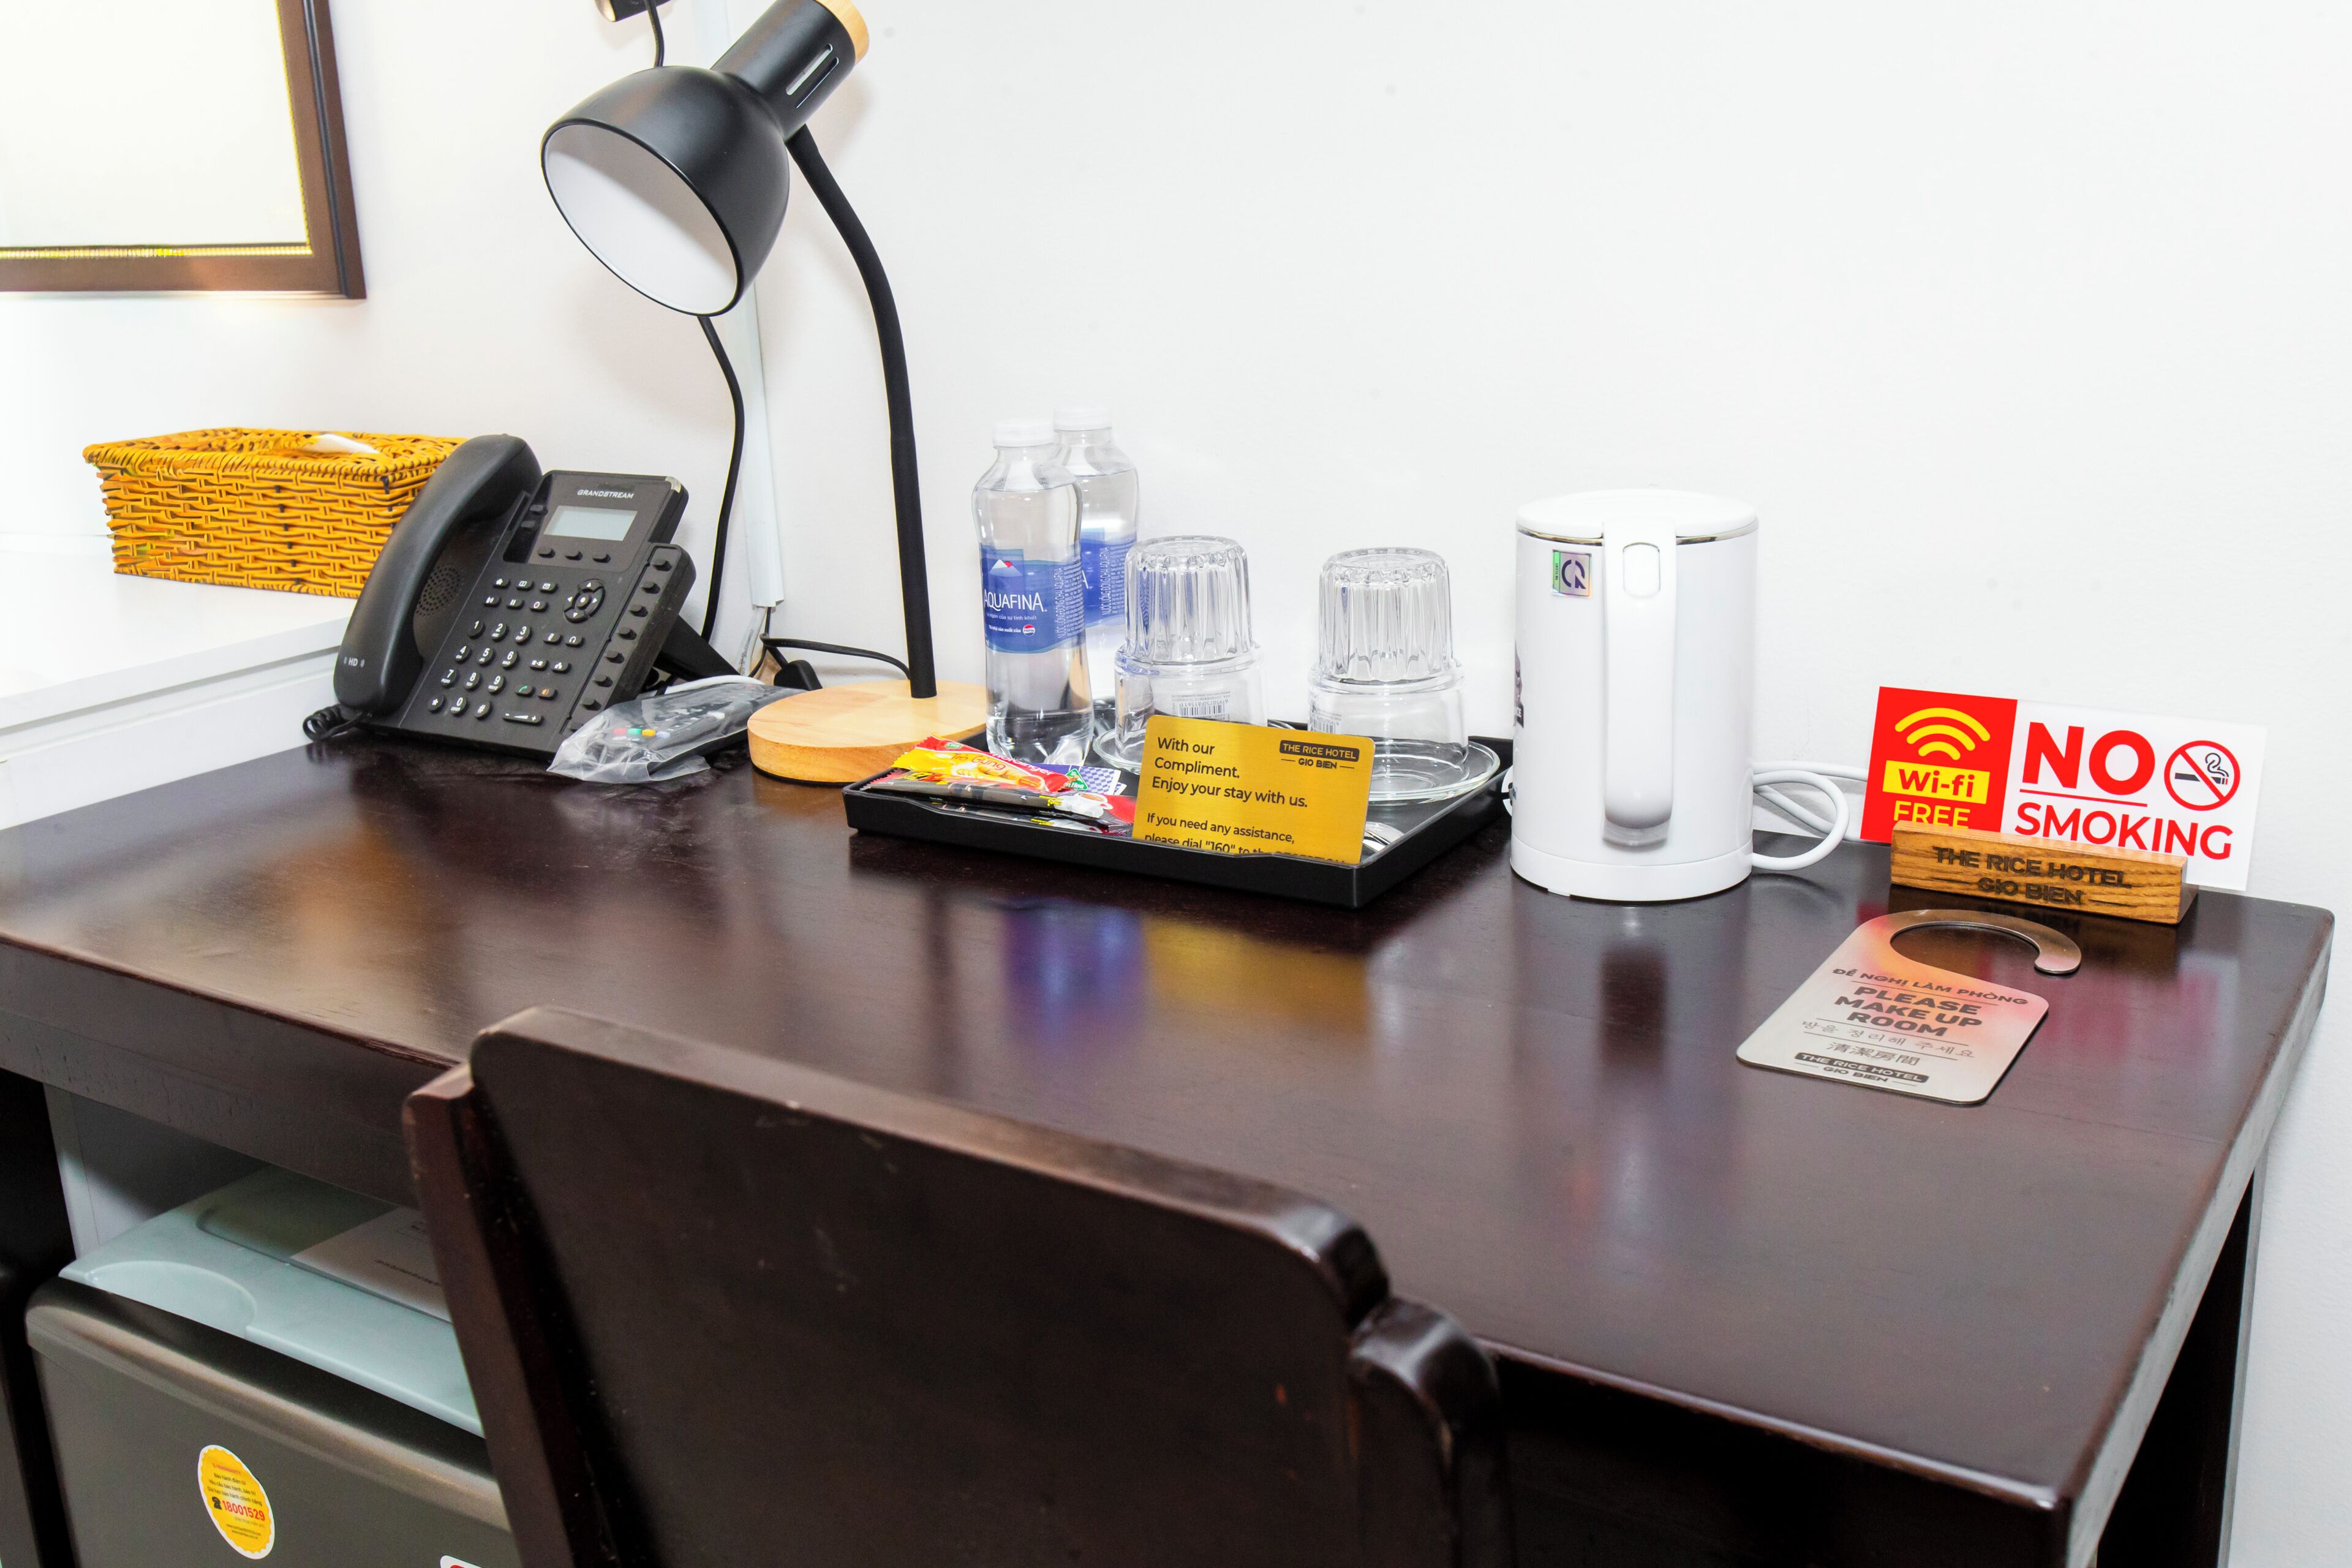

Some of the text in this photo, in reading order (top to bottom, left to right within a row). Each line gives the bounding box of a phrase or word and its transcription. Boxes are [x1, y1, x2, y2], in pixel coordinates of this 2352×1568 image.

[578, 489, 635, 499] GRANDSTREAM
[984, 589, 1045, 612] AQUAFINA
[473, 620, 480, 629] 1
[495, 623, 503, 632] 2
[520, 626, 527, 635] 3
[459, 646, 467, 654] 4
[483, 648, 491, 657] 5
[507, 651, 514, 660] 6
[348, 657, 358, 667] HD
[447, 669, 454, 678] 7
[469, 672, 477, 682] 8
[494, 676, 501, 685] 9
[457, 697, 464, 706] 0
[1158, 737, 1215, 755] With our
[1283, 743, 1357, 760] THE RICE HOTEL
[1155, 756, 1240, 778] Compliment.
[1298, 758, 1338, 769] GIO BIEN
[2022, 722, 2155, 796] NO
[1152, 776, 1308, 807] Enjoy your stay with us.
[1899, 769, 1975, 797] Wi-fi
[1893, 800, 1971, 829] FREE
[1147, 813, 1295, 845] If you need any assistance,
[2015, 802, 2234, 860] SMOKING
[1182, 838, 1202, 849] dial
[1932, 846, 2133, 889] THE RICE HOTEL
[1977, 877, 2084, 906] GIO BIEN
[1853, 986, 1982, 1015] PLEASE
[1834, 996, 1983, 1027] MAKE UP
[1847, 1011, 1948, 1036] ROOM
[1802, 1020, 1975, 1058] 방을 정리해 주세요
[1826, 1042, 1921, 1066] 清潔房間
[1801, 1054, 1923, 1082] THE RICE HOTEL
[1823, 1066, 1889, 1083] GIO BIEN
[222, 1500, 265, 1521] 18001529
